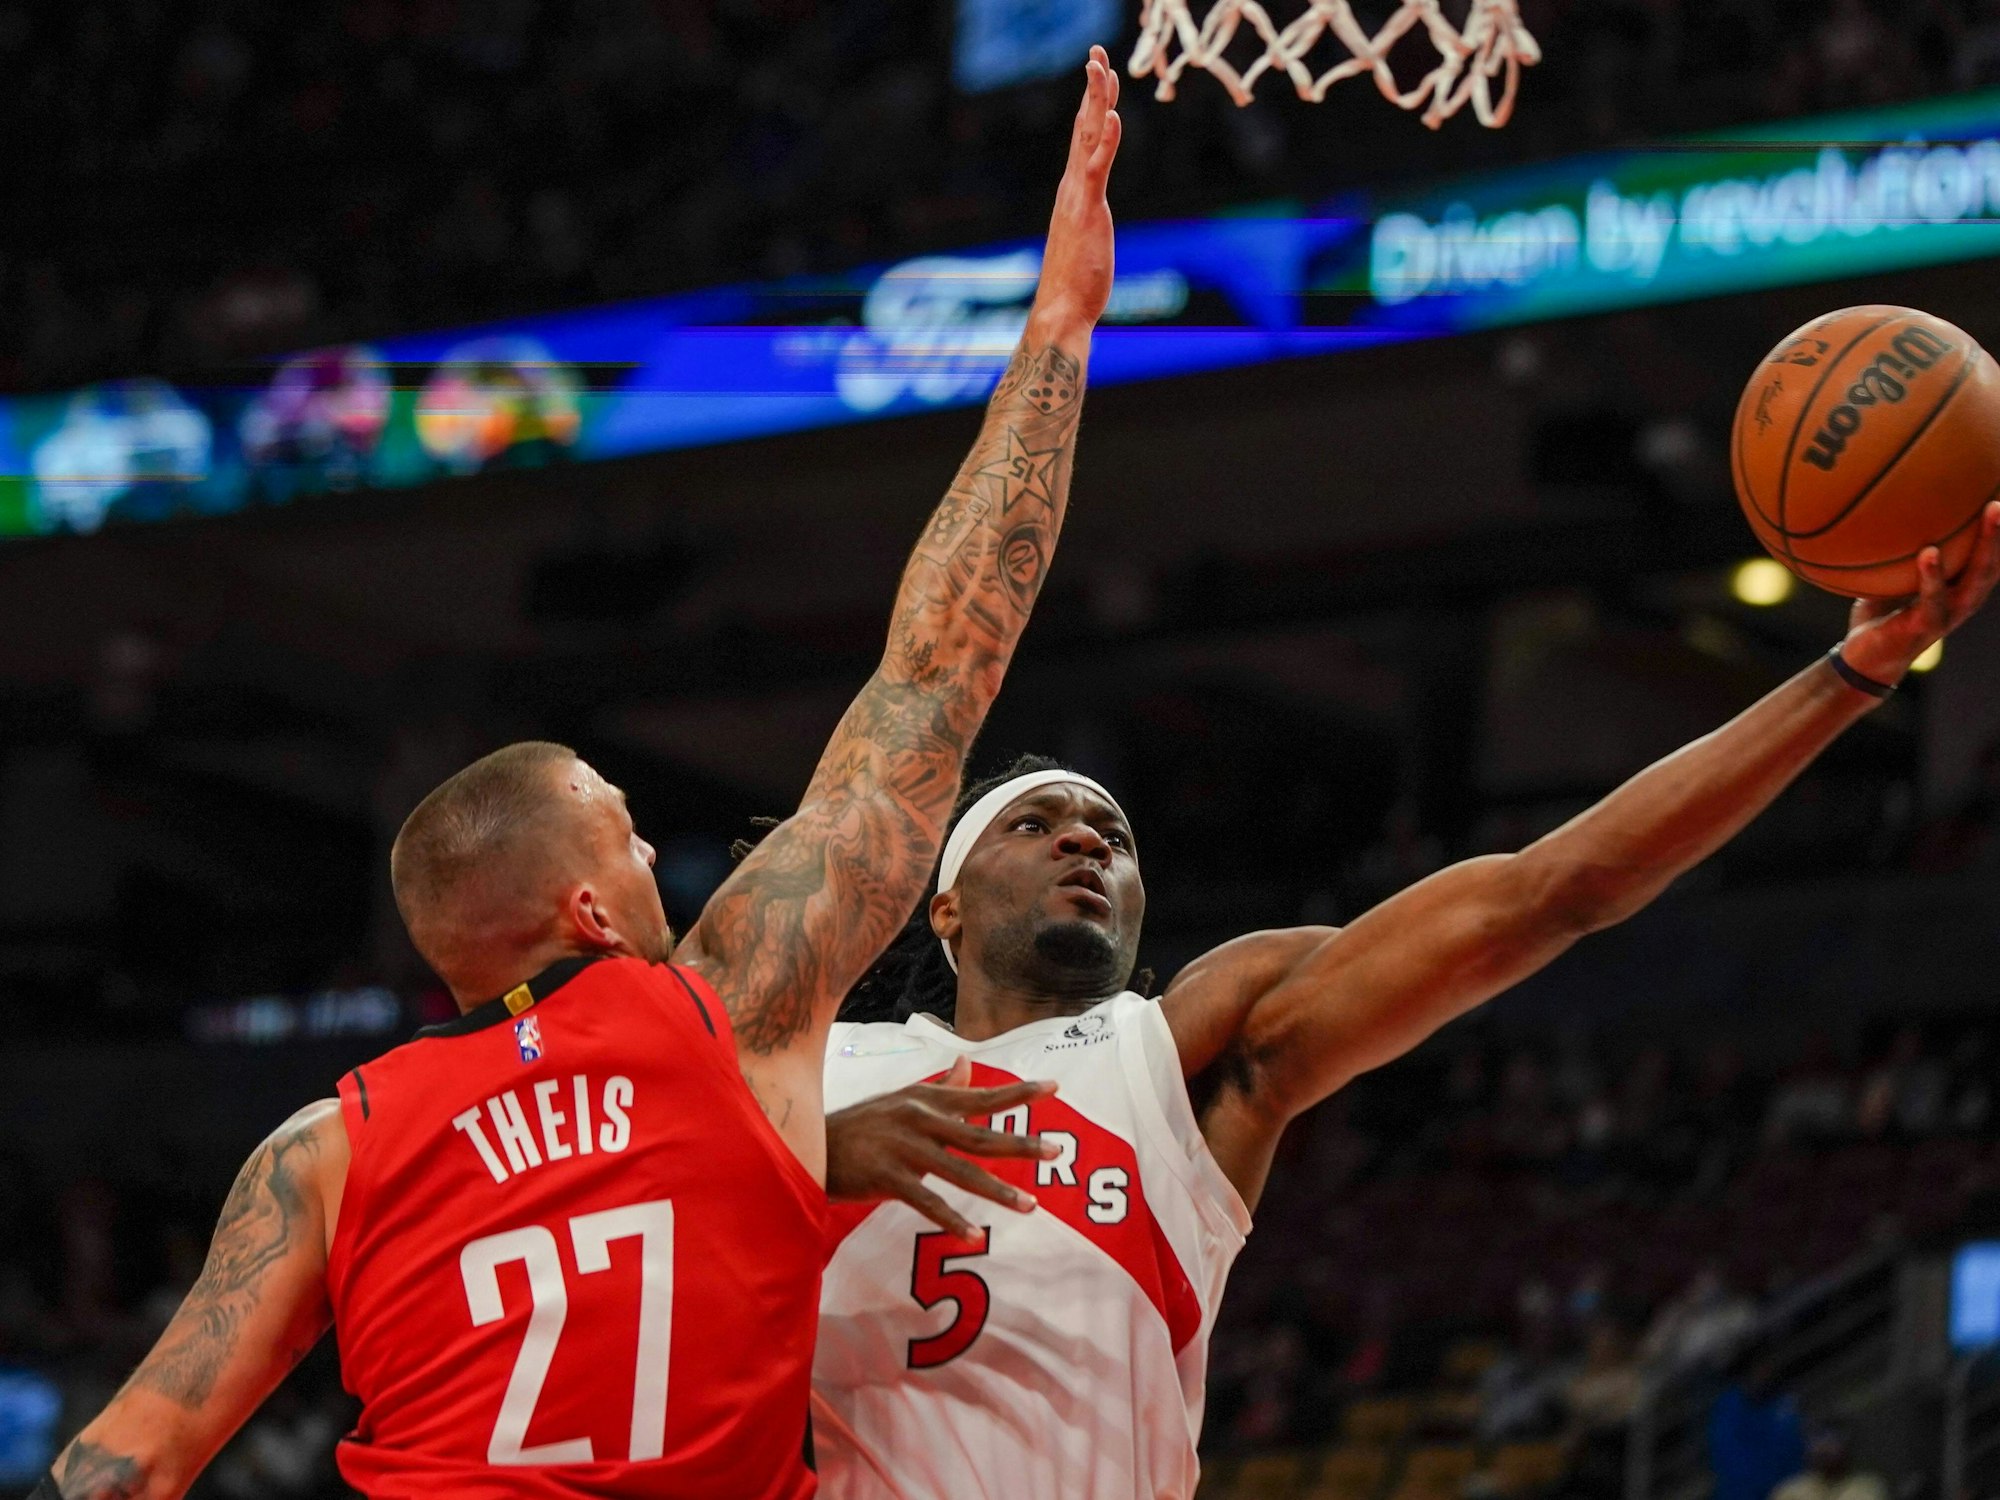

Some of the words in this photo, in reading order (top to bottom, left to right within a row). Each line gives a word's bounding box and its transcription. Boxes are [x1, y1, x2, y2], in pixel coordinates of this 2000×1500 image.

[1371, 203, 1581, 304] Driven
[1587, 180, 1674, 287] by
[1803, 326, 1954, 471] Wilson
[1008, 456, 1036, 484] 15
[452, 1075, 634, 1184] THEIS
[459, 1199, 674, 1466] 27
[907, 1225, 991, 1370] 5
